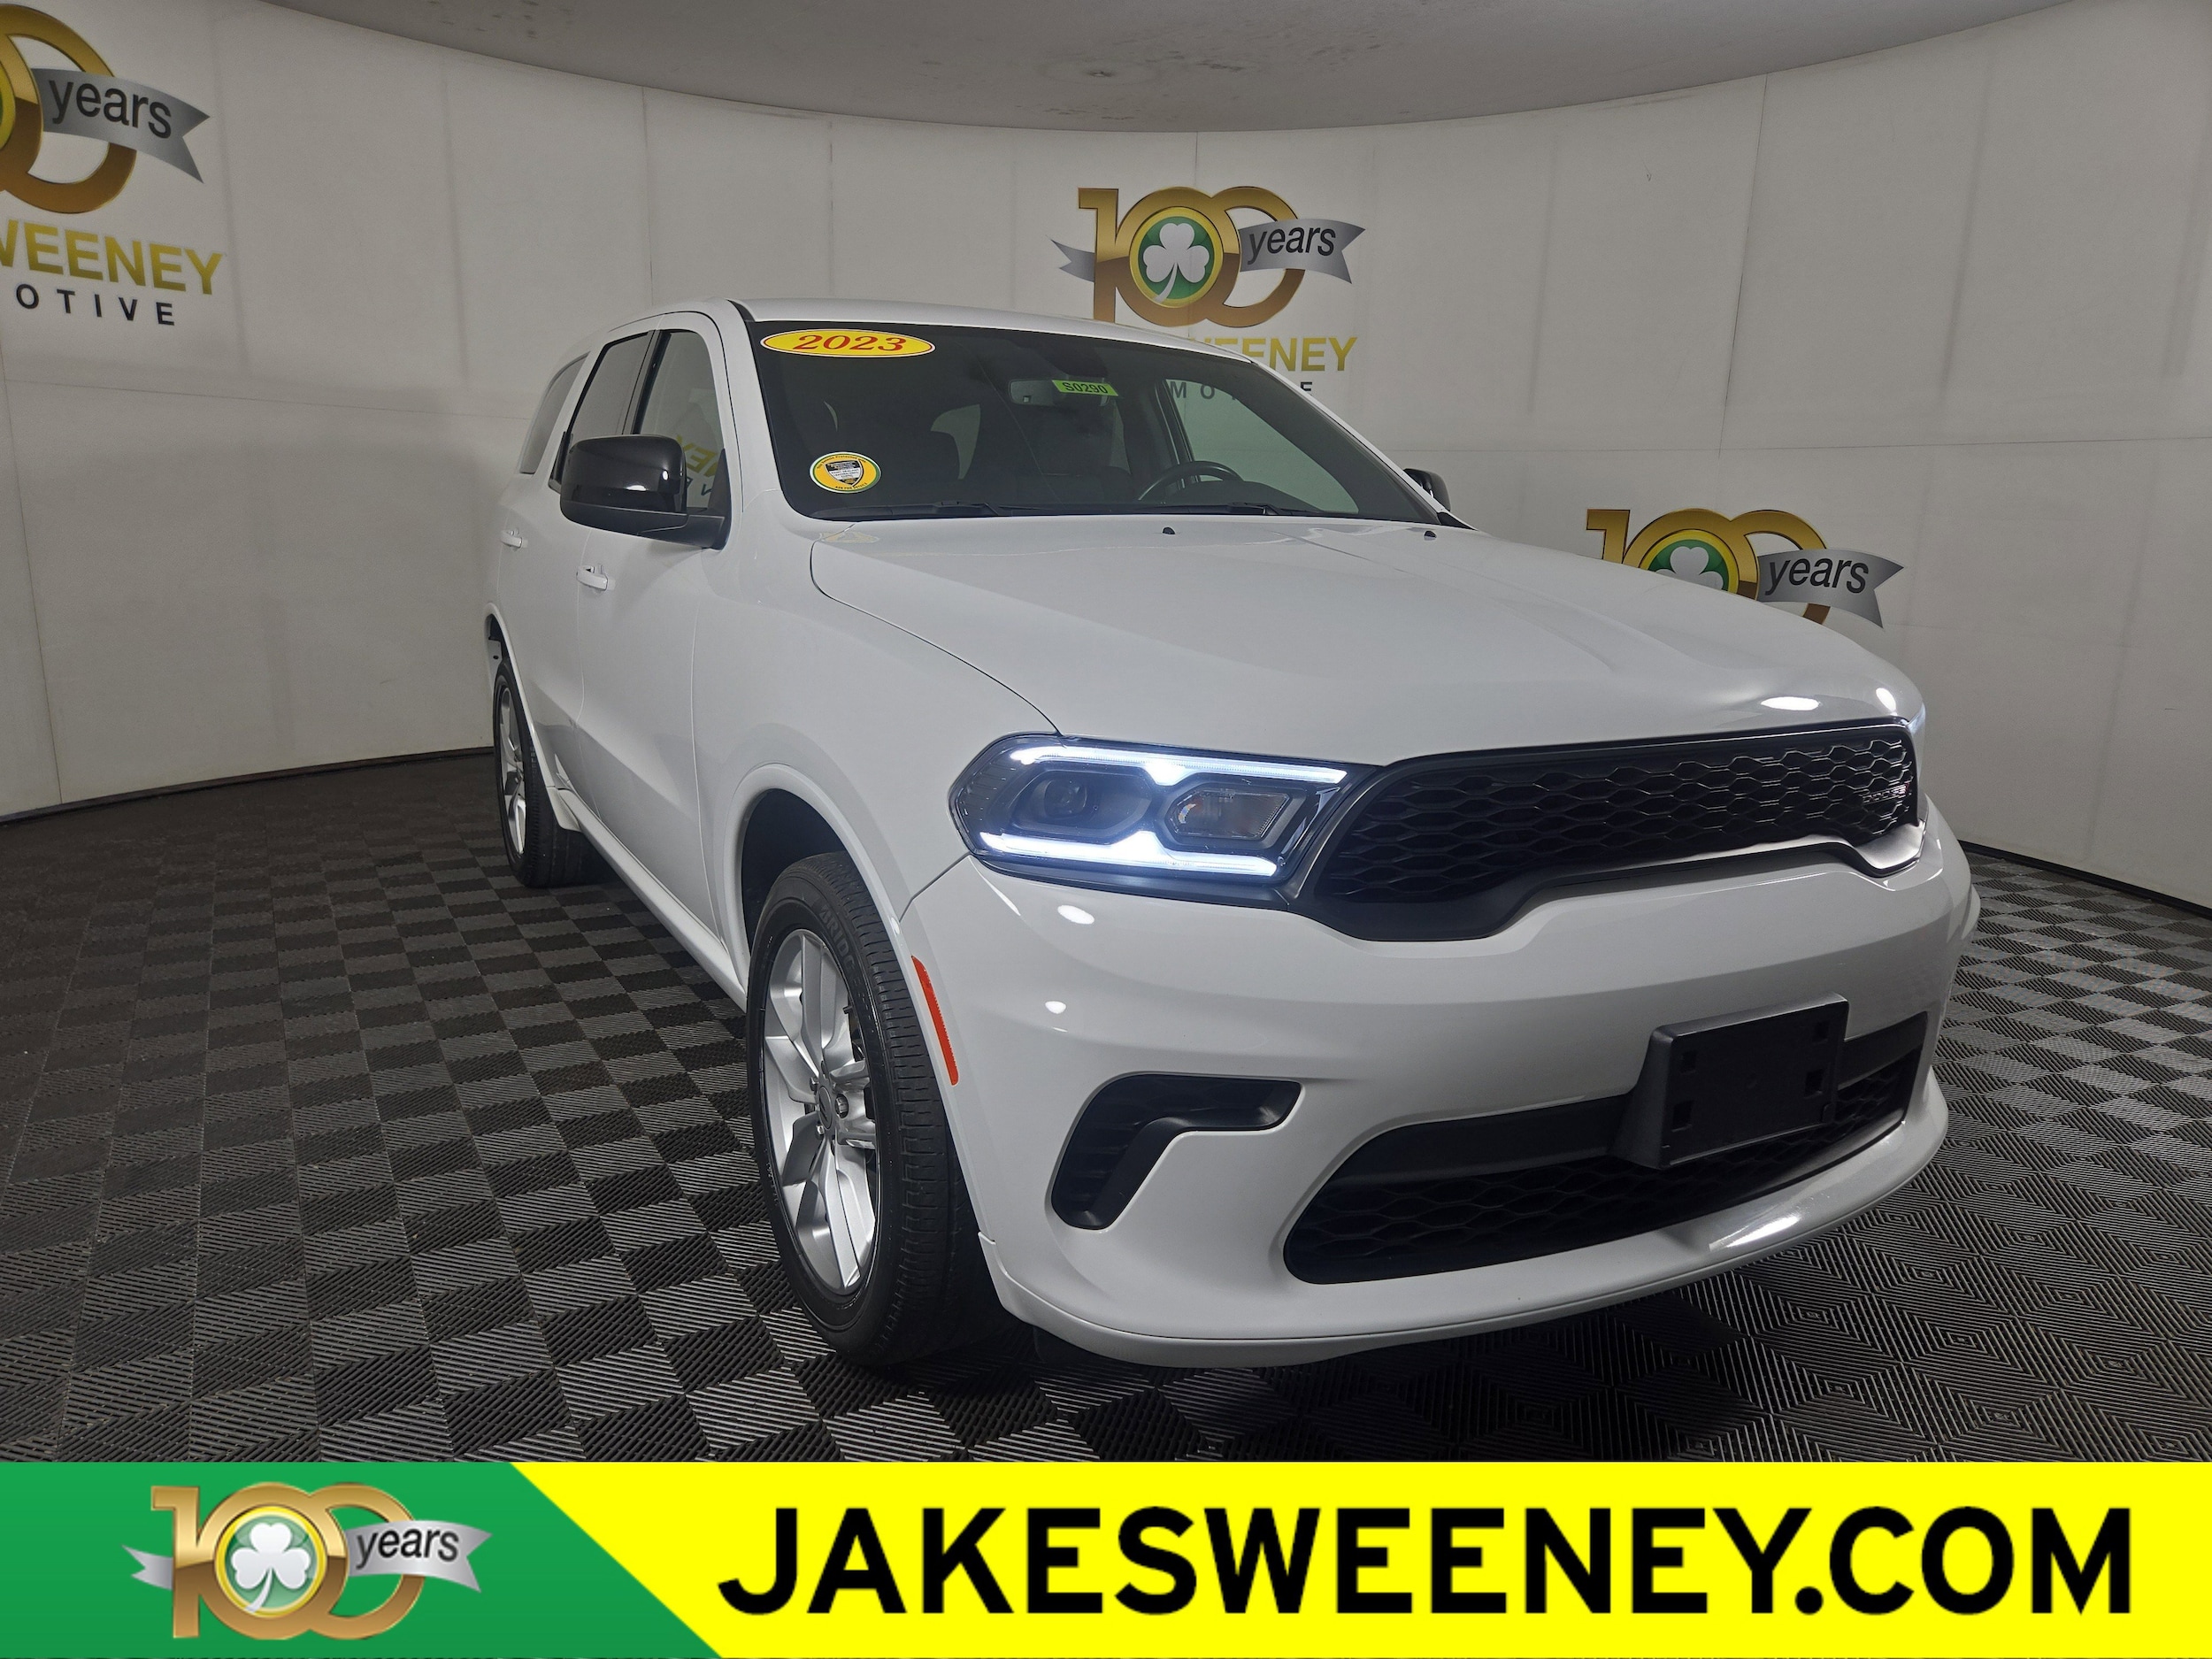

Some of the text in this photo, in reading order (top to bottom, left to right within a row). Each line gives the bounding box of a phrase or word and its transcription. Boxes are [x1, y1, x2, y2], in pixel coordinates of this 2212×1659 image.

[49, 79, 173, 139] years
[1077, 186, 1337, 328] 100 years
[793, 334, 907, 351] 2023
[1062, 381, 1109, 394] S0290
[1764, 557, 1870, 595] years
